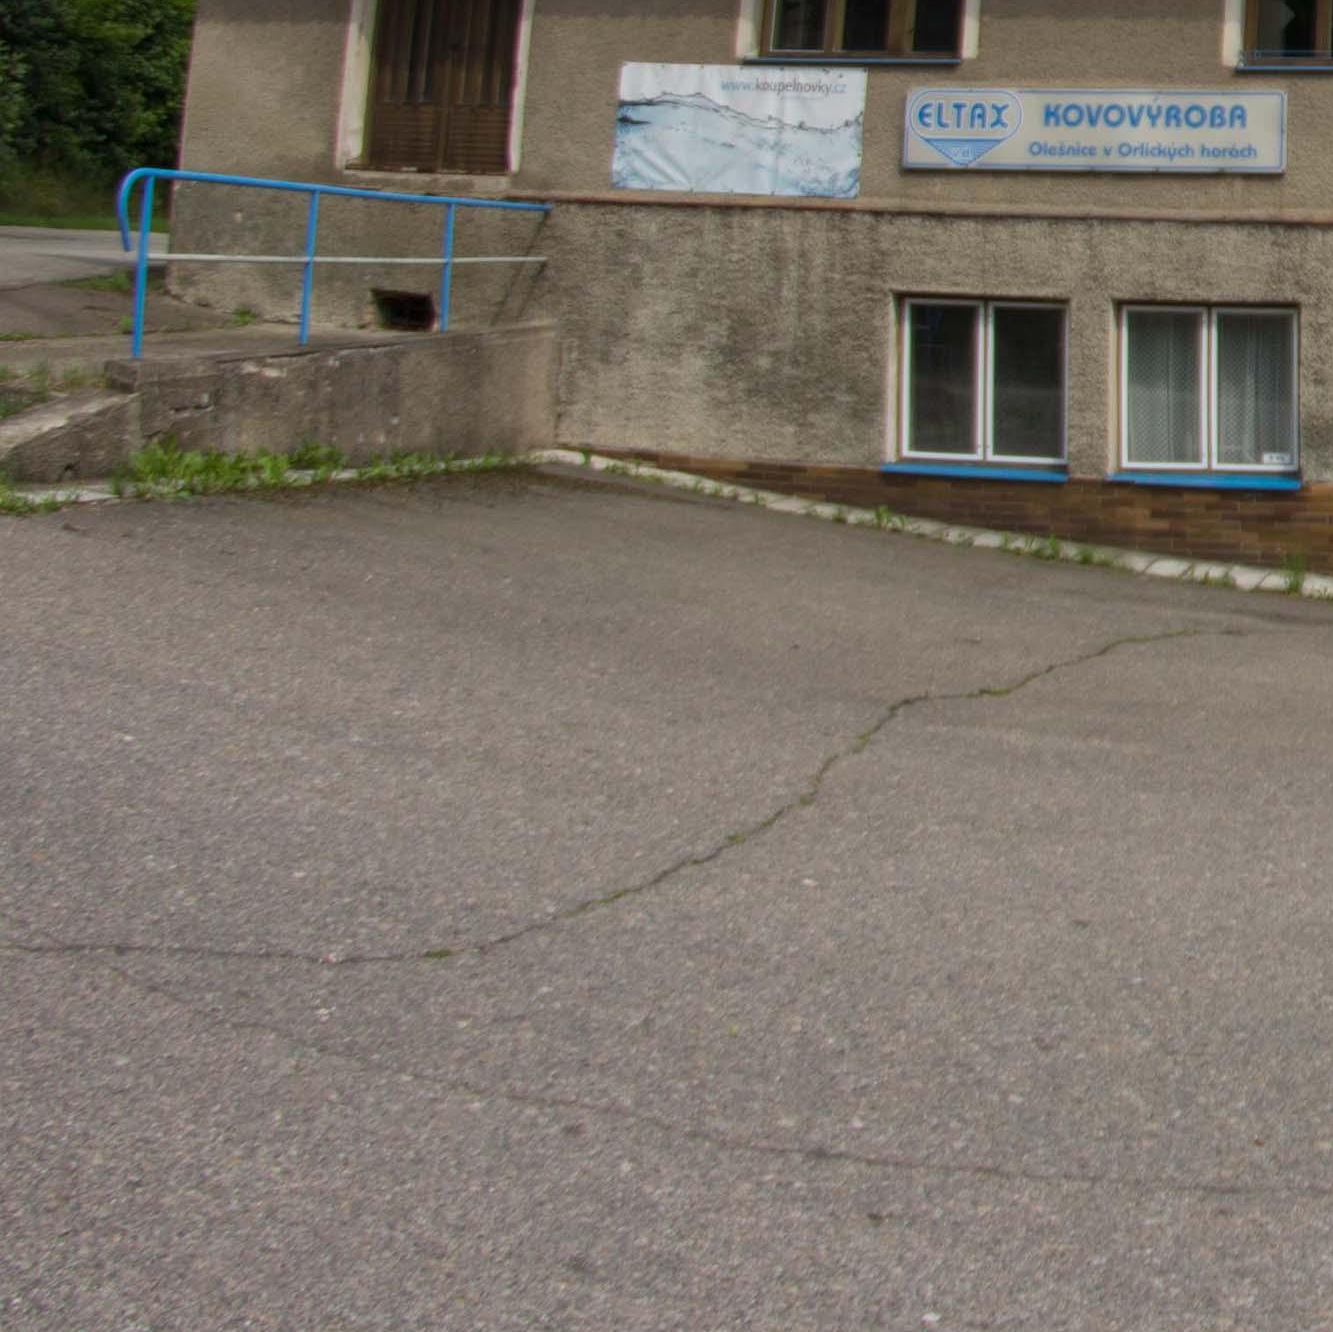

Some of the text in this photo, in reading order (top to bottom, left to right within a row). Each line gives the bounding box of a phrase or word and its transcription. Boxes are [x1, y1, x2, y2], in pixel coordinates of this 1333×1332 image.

[918, 102, 1009, 128] ELTAX
[1042, 96, 1248, 129] KOVOVÝROBA
[1028, 141, 1258, 162] Olešnice v Orlických horách
